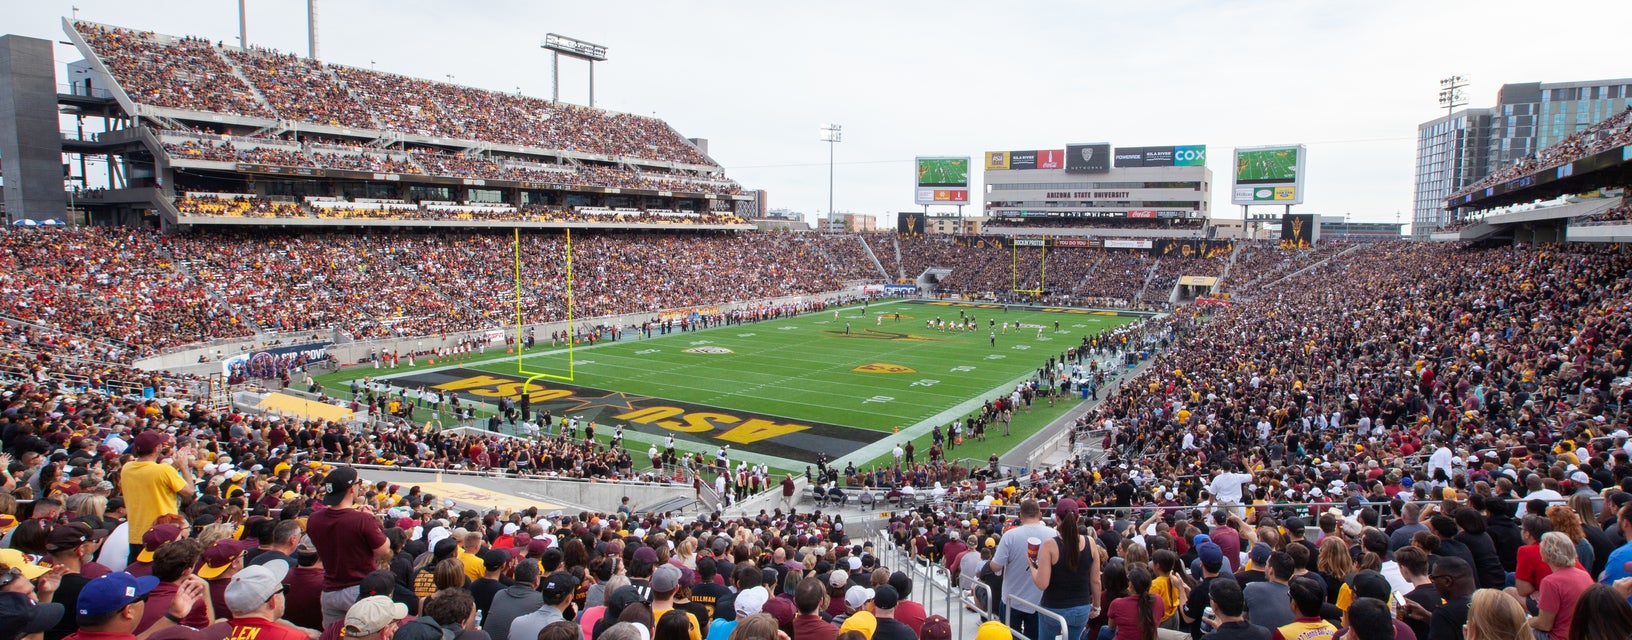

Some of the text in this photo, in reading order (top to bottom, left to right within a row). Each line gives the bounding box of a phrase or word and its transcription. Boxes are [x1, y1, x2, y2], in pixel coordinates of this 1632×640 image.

[1175, 150, 1205, 161] COX
[1046, 191, 1130, 199] ARIZONA STATE UNIVERSITY
[431, 377, 577, 404] ASU
[611, 405, 813, 445] ASU
[691, 595, 716, 603] TILLMAN
